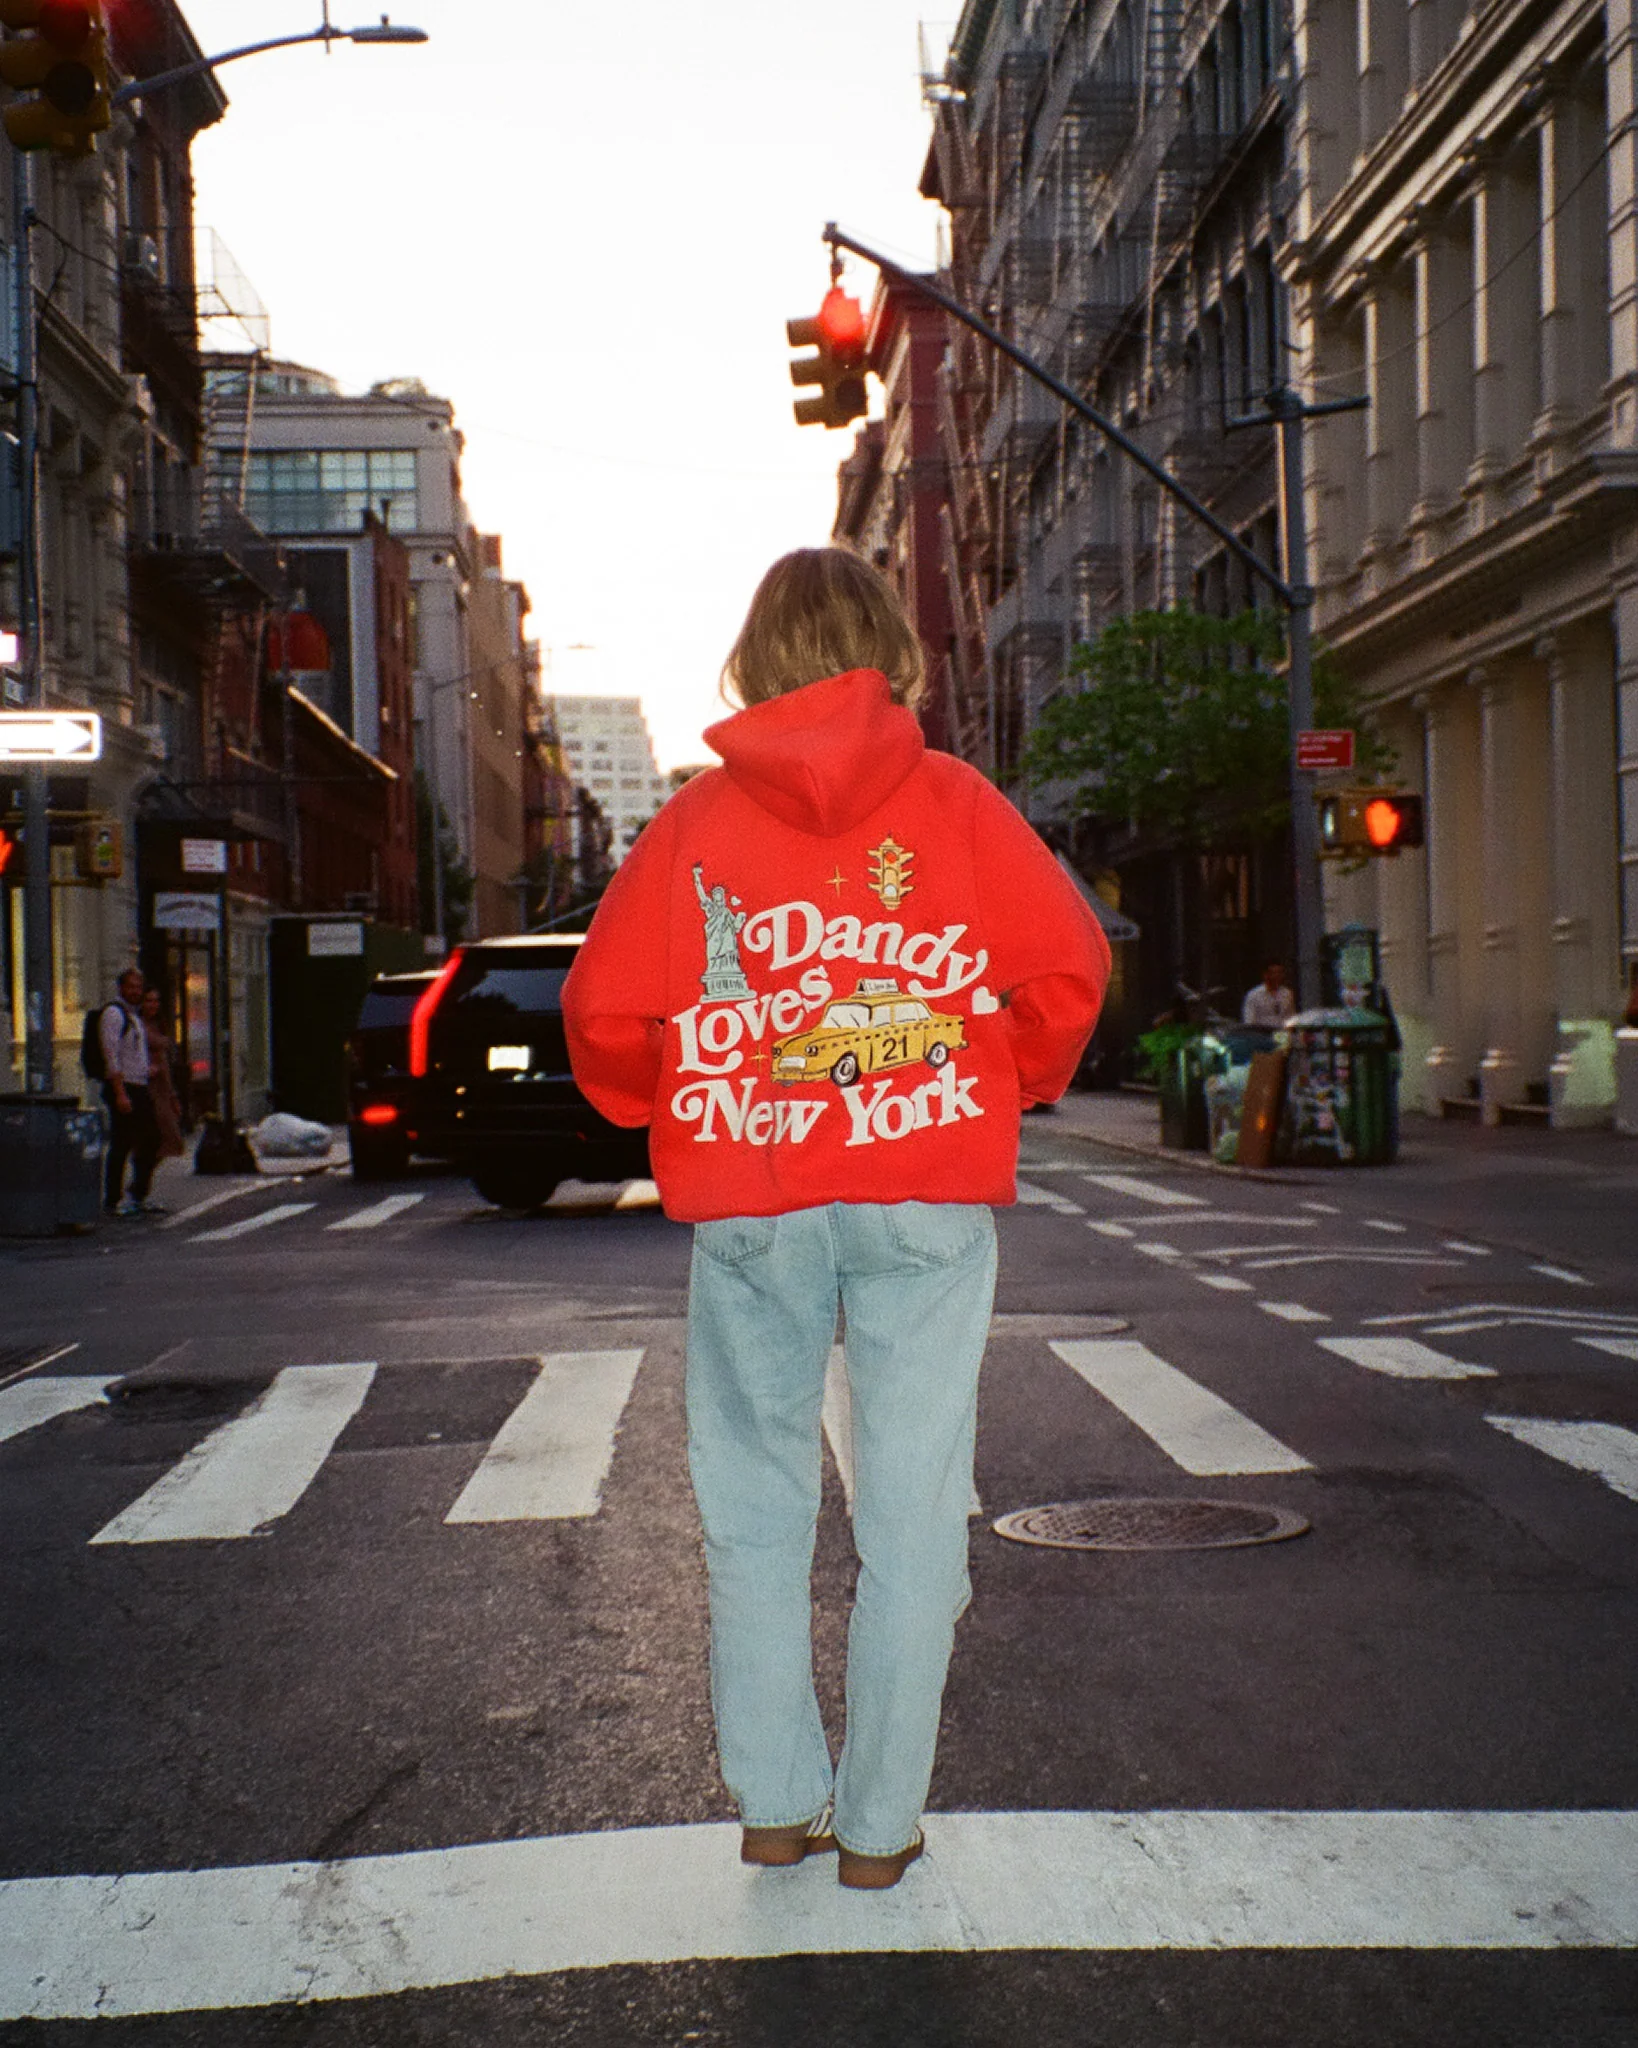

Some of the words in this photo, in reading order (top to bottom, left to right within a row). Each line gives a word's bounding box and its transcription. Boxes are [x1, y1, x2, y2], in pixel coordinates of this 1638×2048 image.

[744, 901, 988, 997] Dandy
[672, 966, 832, 1074] Loves
[882, 1037, 909, 1062] 21
[672, 1078, 828, 1146] New
[841, 1062, 985, 1147] York
